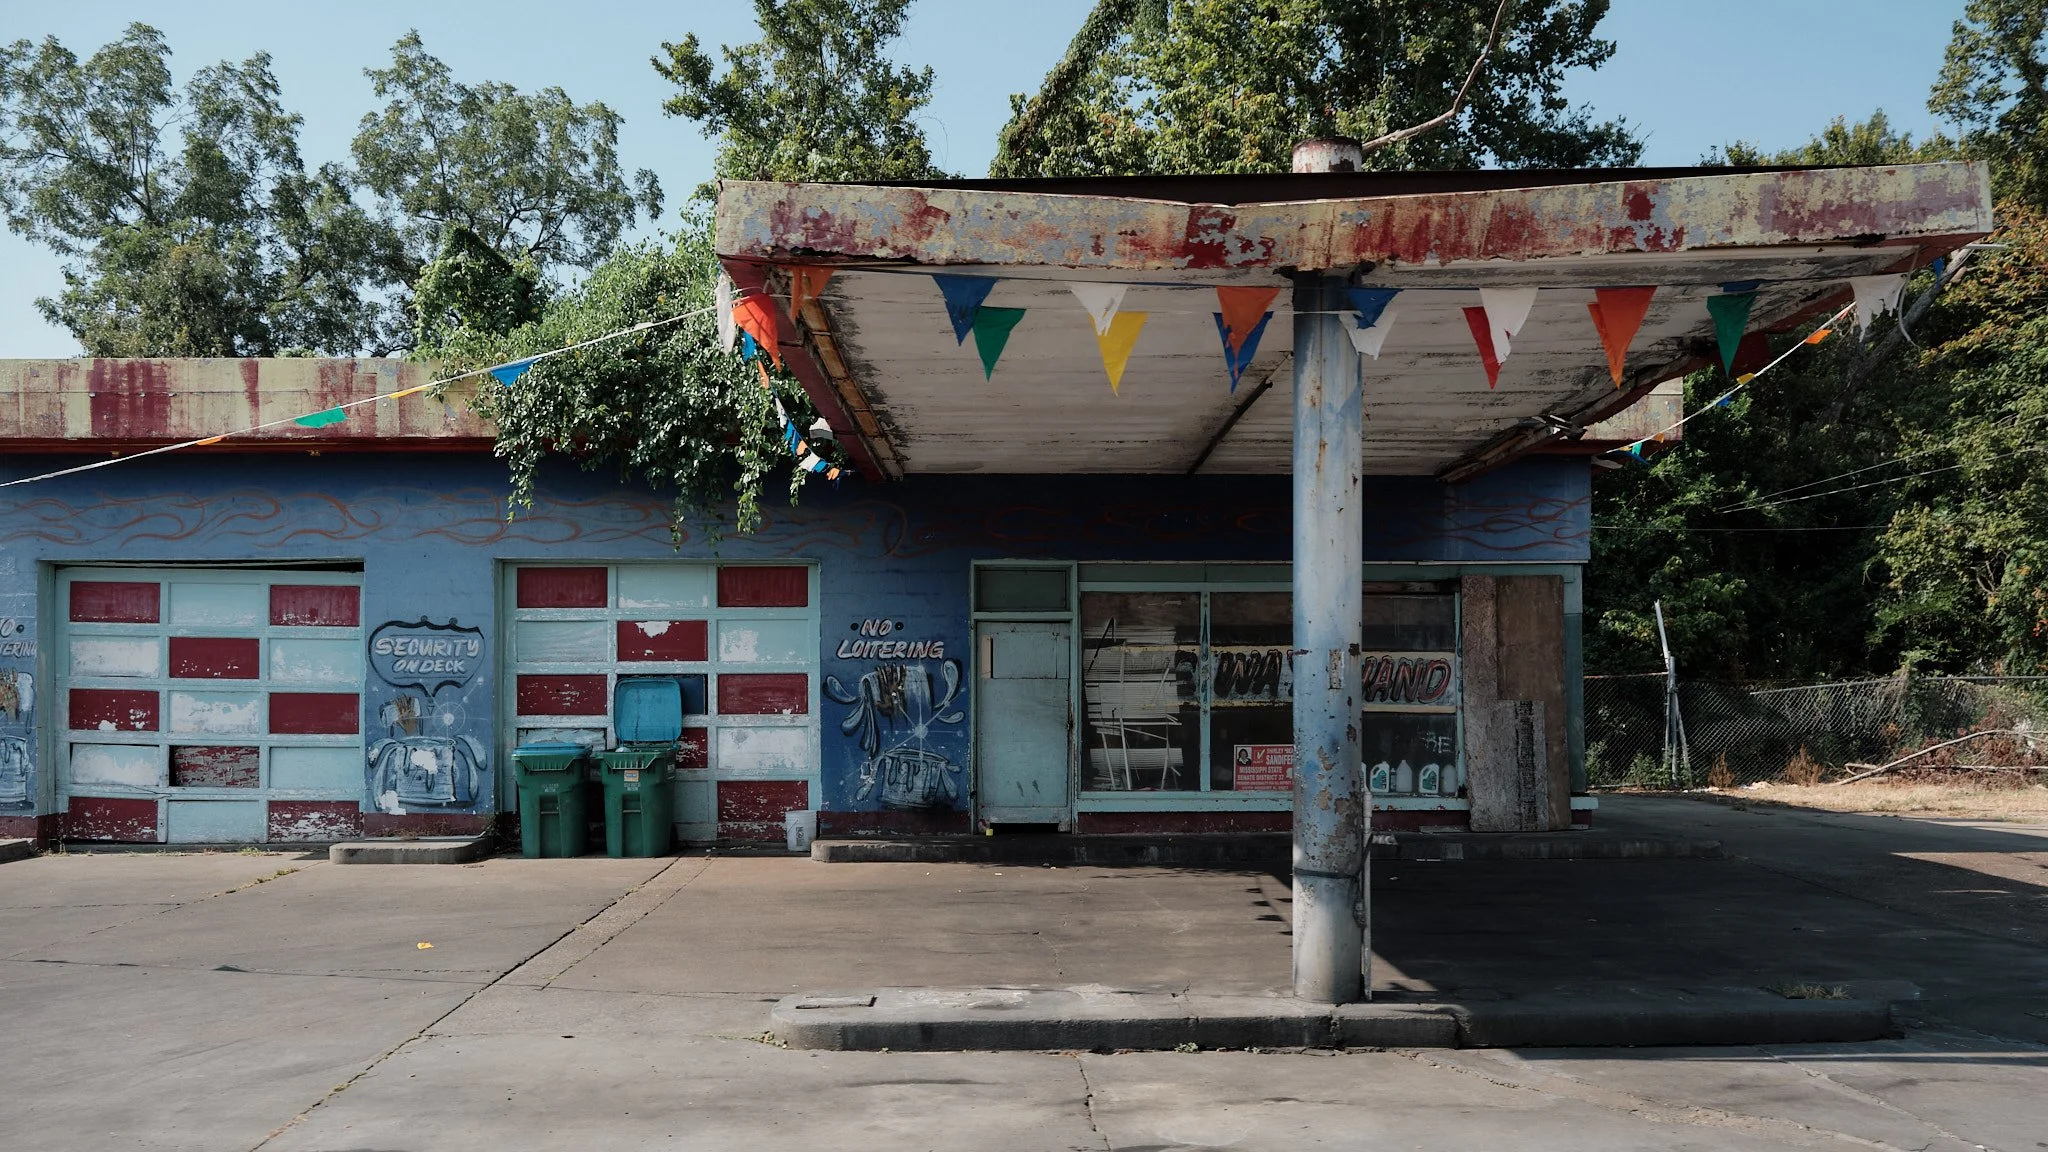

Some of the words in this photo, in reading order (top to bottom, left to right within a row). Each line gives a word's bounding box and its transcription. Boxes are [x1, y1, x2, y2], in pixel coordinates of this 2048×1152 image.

[860, 618, 892, 637] NO
[375, 637, 479, 657] SECURITY
[836, 639, 944, 660] LOITERING
[419, 660, 466, 674] DECK
[1213, 649, 1294, 698] WA
